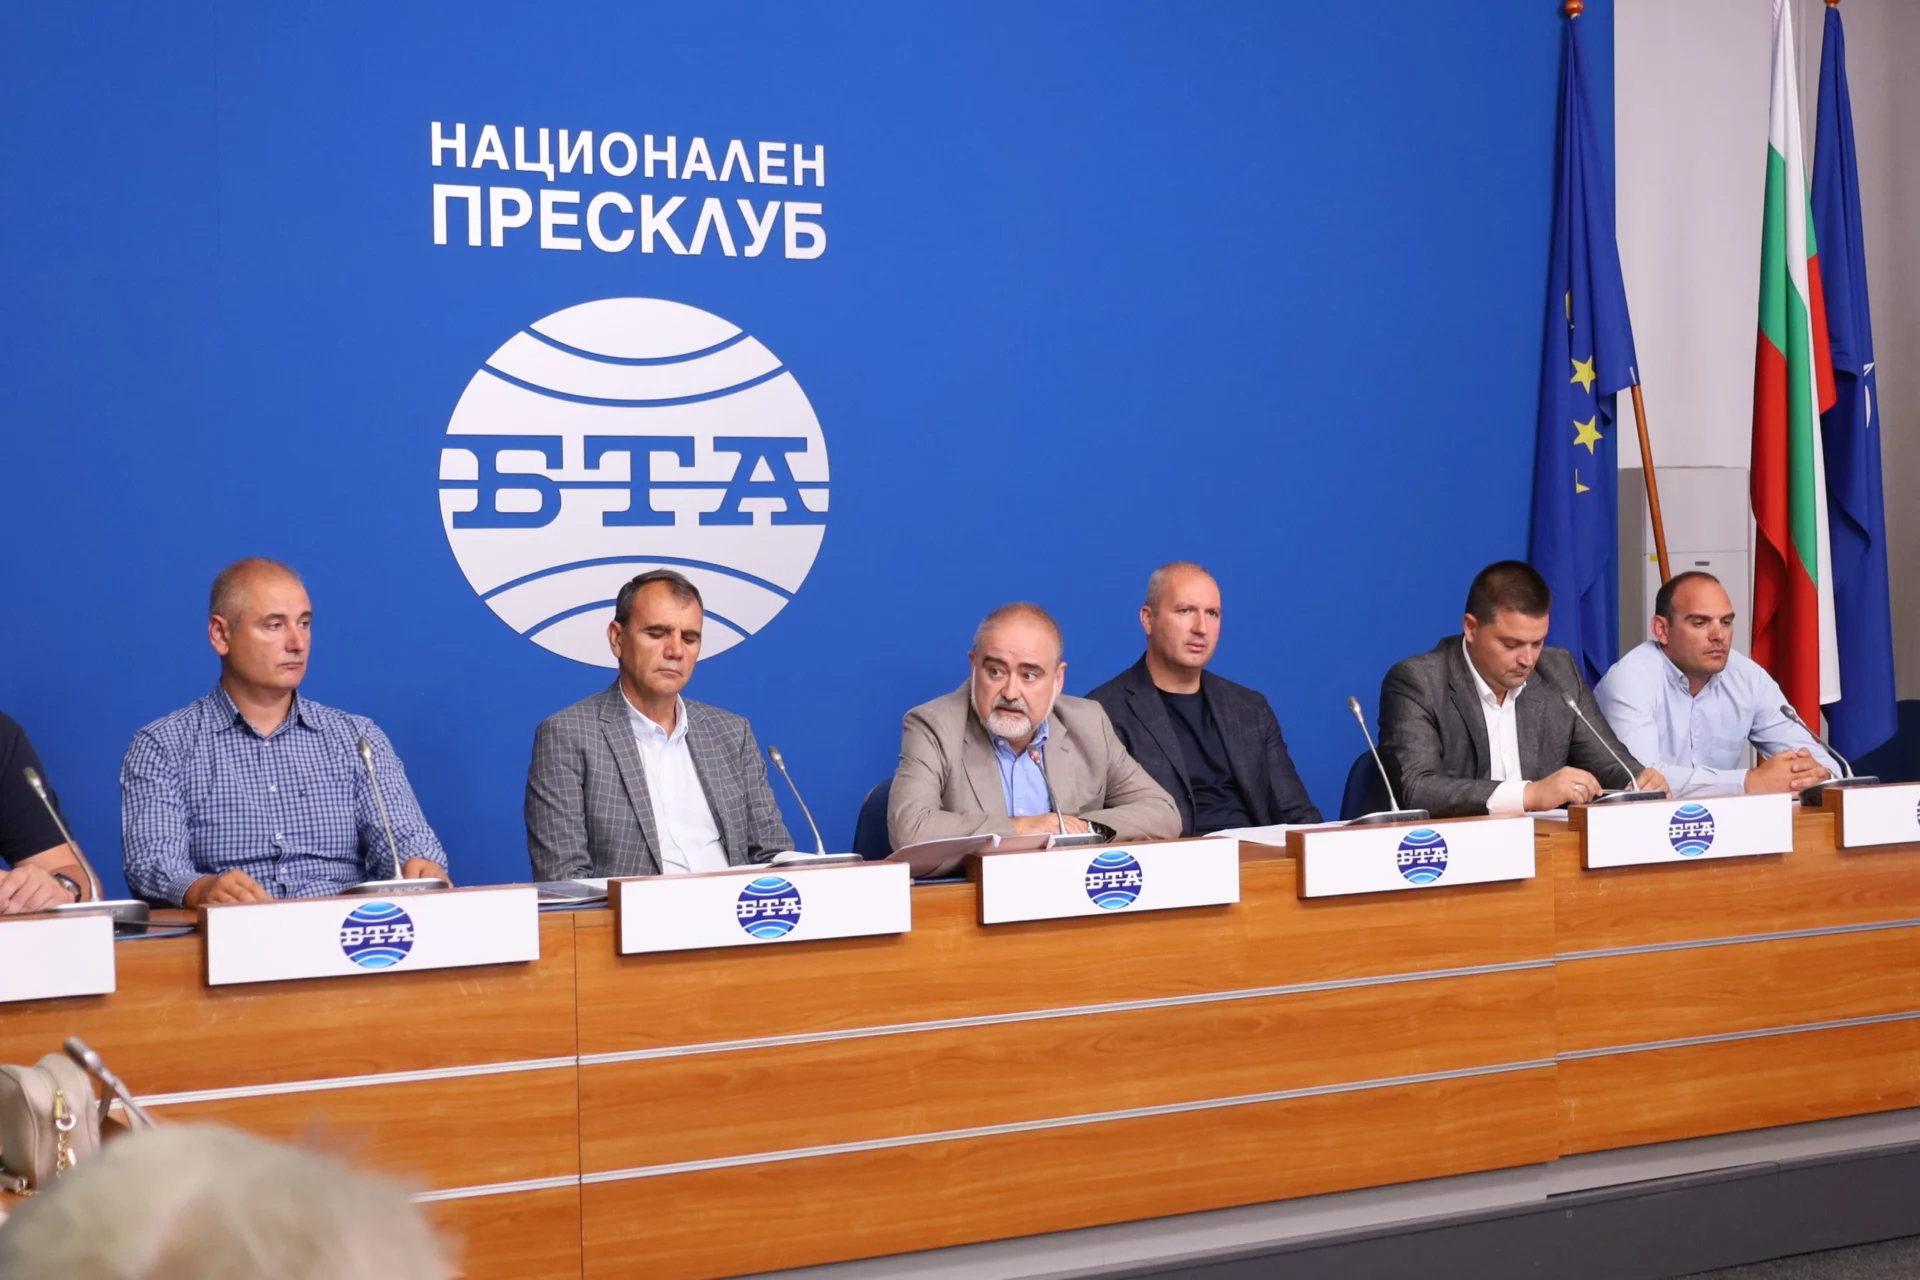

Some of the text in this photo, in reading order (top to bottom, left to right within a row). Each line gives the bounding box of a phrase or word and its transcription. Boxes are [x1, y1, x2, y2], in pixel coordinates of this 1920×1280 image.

[431, 121, 825, 187] НАЦИОНАЛЕН
[432, 183, 827, 260] ПРЕСКЛУБ
[446, 434, 828, 529] БТА
[1669, 821, 1714, 839] БТА
[1397, 847, 1447, 866] БТА
[1086, 869, 1142, 890] БТА
[737, 896, 801, 918] БТА
[341, 923, 414, 947] БТА
